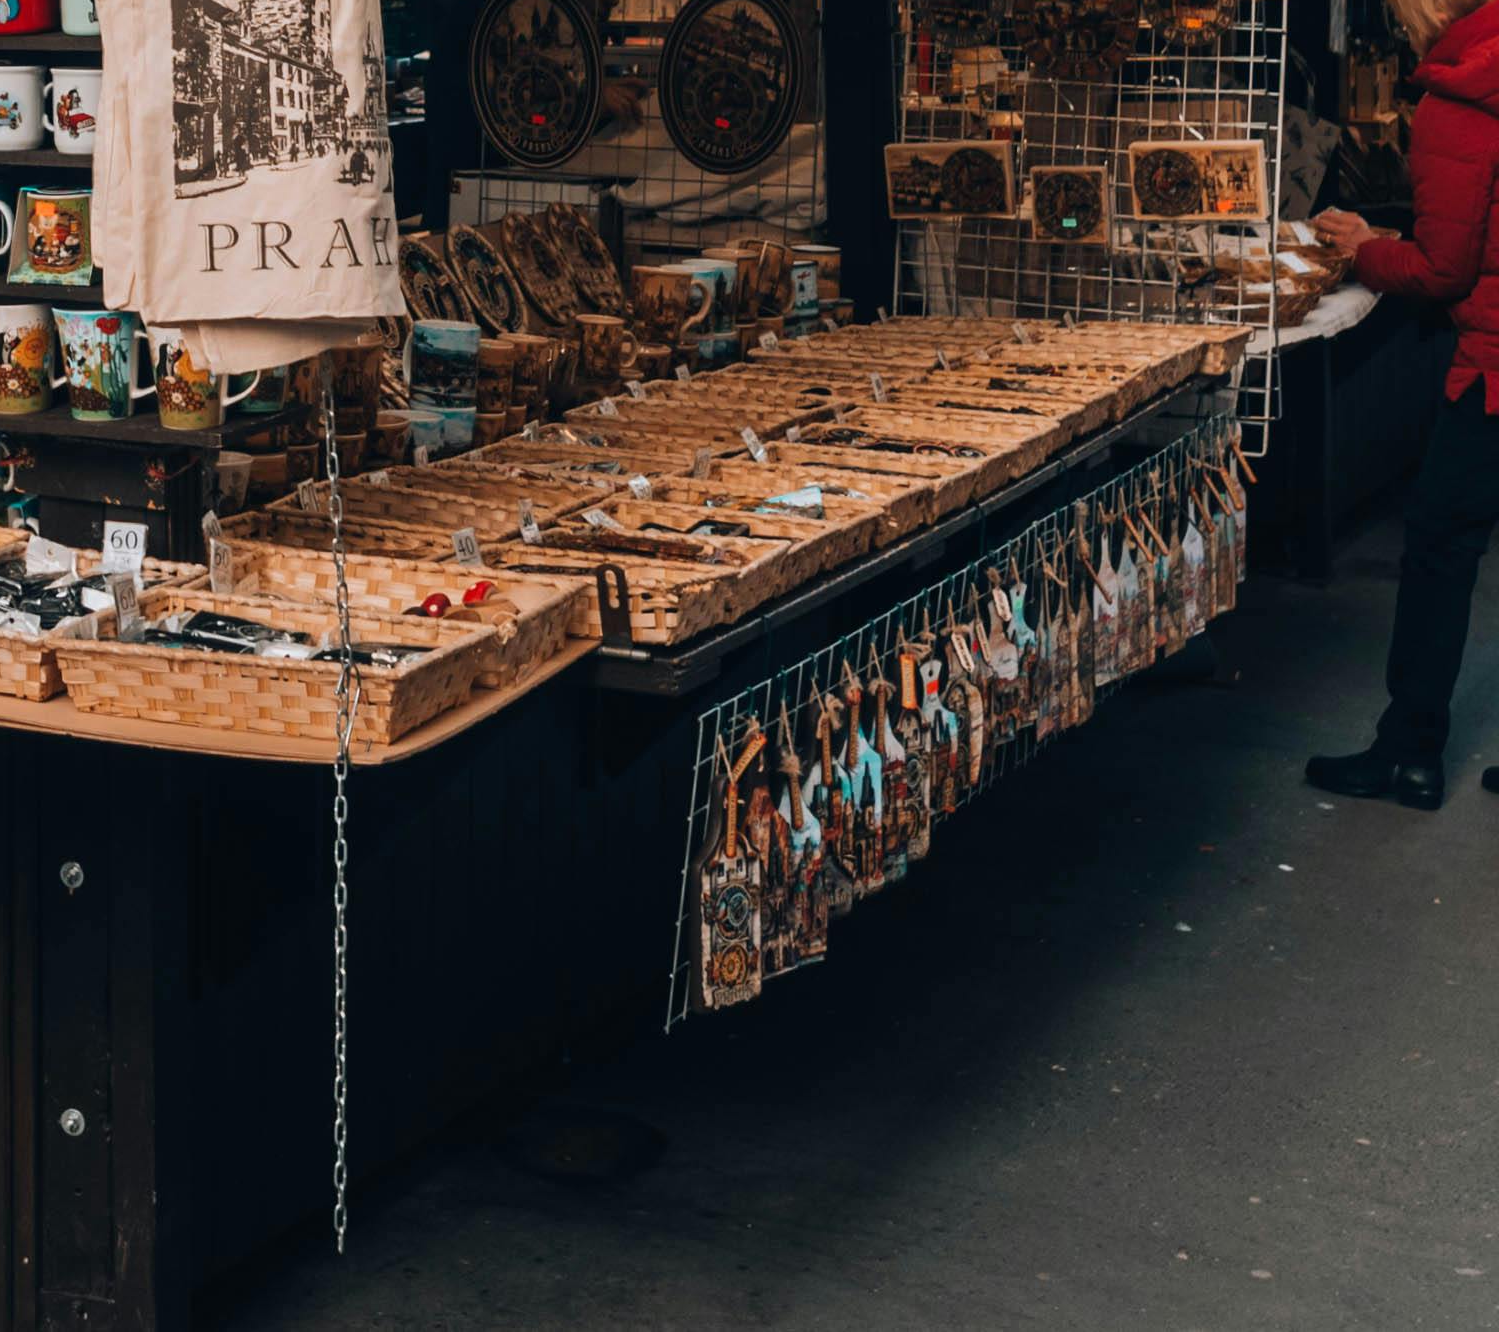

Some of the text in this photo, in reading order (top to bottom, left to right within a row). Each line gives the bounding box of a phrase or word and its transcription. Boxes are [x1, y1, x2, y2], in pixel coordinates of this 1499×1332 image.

[198, 217, 392, 273] PRAH
[110, 529, 139, 550] 60
[457, 537, 476, 557] 40
[213, 547, 230, 567] 60
[120, 589, 137, 611] 60
